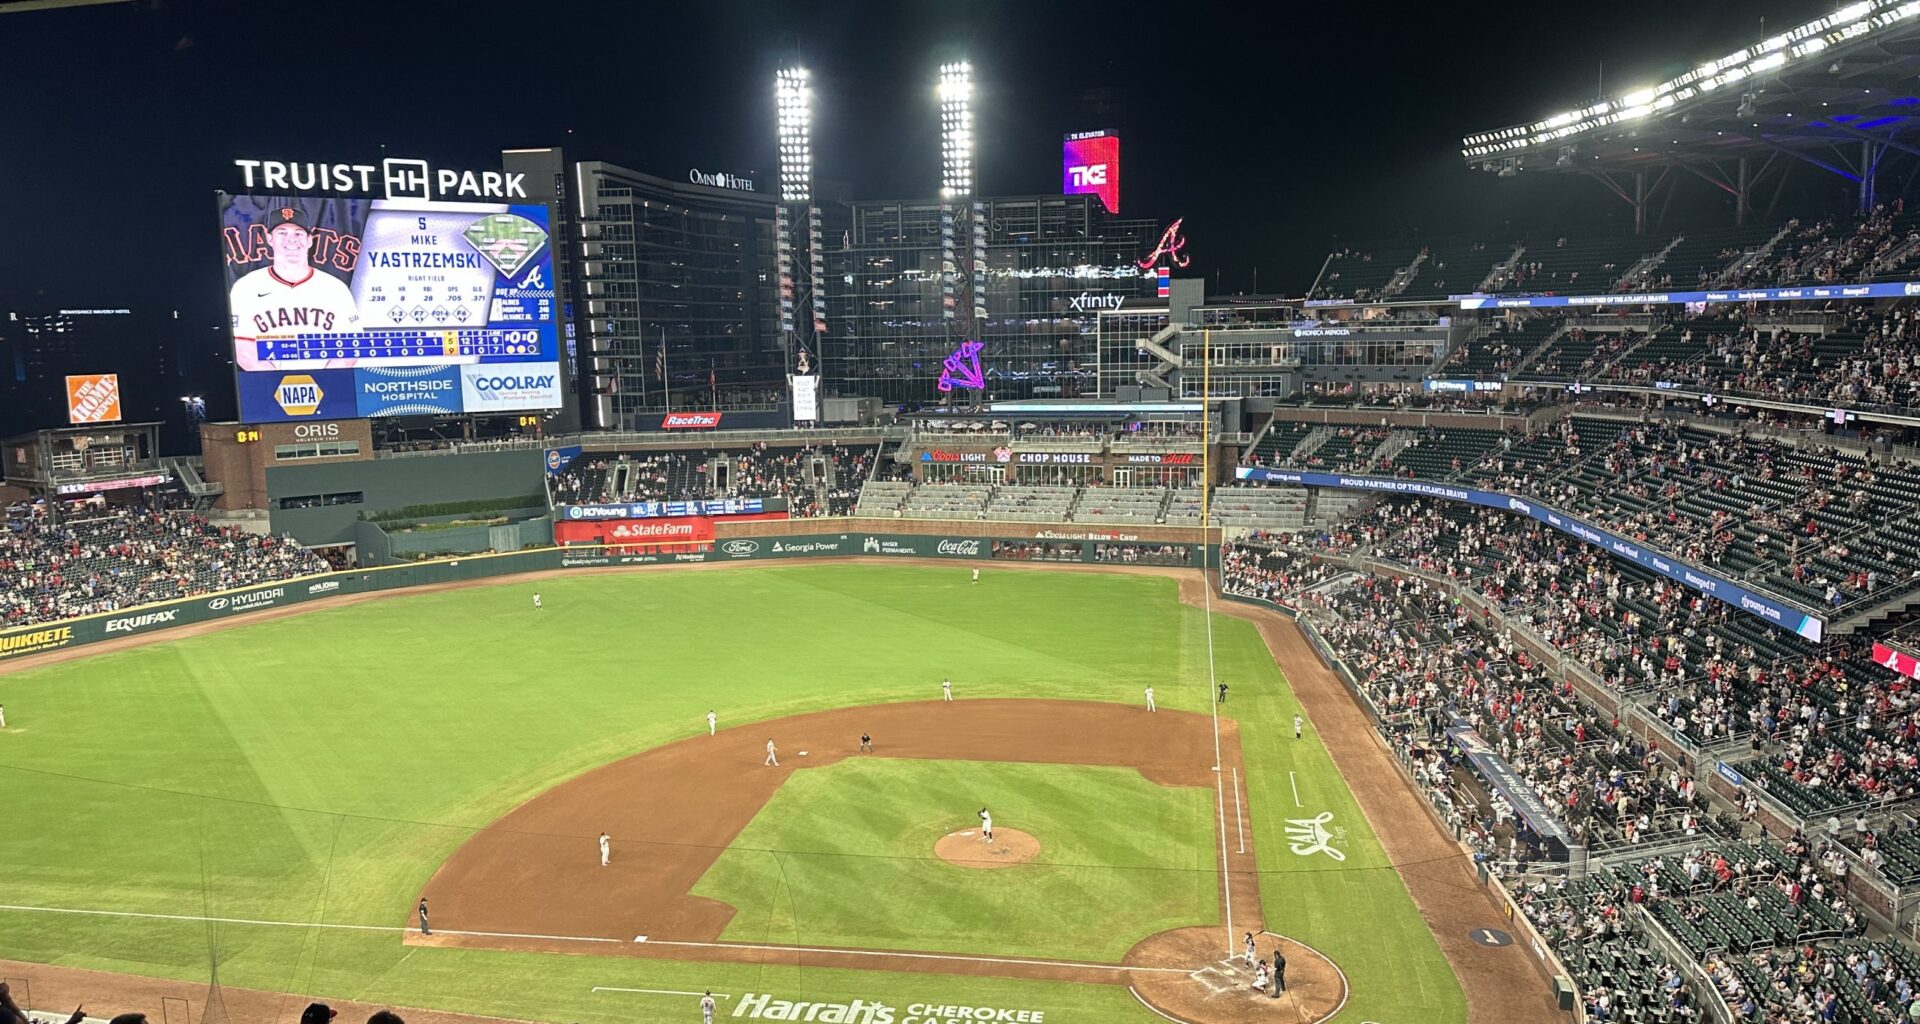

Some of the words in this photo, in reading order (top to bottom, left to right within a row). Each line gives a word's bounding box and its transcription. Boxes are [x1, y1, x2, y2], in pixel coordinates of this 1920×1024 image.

[1079, 130, 1105, 139] ELEVATOR
[235, 159, 375, 192] TRUIST
[438, 169, 527, 199] PARK
[690, 168, 716, 186] OMNI
[725, 173, 755, 191] HOTEL
[1069, 164, 1107, 187] TKE
[411, 235, 438, 245] MIKE
[368, 251, 481, 269] YASTRZEMSKI
[1069, 291, 1125, 313] xfinity
[253, 307, 335, 333] GIANTS
[303, 340, 308, 348] 1
[320, 339, 325, 348] 1
[336, 339, 343, 348] 0
[352, 339, 359, 347] 0
[370, 338, 375, 347] 1
[384, 338, 392, 346] 0
[401, 338, 406, 346] 1
[416, 338, 423, 346] 0
[461, 337, 470, 345] 12
[477, 337, 484, 345] 2
[509, 331, 521, 344] 0
[526, 331, 538, 344] 0
[304, 350, 311, 359] 5
[320, 350, 328, 358] 0
[337, 349, 344, 358] 0
[353, 349, 361, 357] 3
[369, 349, 377, 357] 0
[387, 348, 392, 356] 1
[401, 348, 409, 356] 0
[449, 347, 455, 355] 9
[463, 346, 470, 354] 8
[478, 346, 485, 354] 0
[493, 346, 500, 354] 7
[74, 380, 95, 399] THE
[365, 379, 453, 393] NORTHSIDE
[476, 375, 555, 391] COOLRAY
[72, 375, 115, 421] HOME
[283, 387, 316, 405] NAPA
[382, 392, 438, 401] HOSPITAL
[90, 391, 118, 421] DEPOT
[667, 416, 715, 425] RaceTrac
[295, 423, 339, 437] ORIS
[932, 449, 960, 462] Coors
[960, 453, 986, 462] LIGHT
[1020, 454, 1049, 463] CHOP
[1053, 454, 1090, 463] HOUSE
[1128, 455, 1150, 463] MADE
[1340, 478, 1364, 487] PROUD
[1365, 480, 1396, 490] PARTNER
[1408, 484, 1421, 492] THE
[1421, 485, 1445, 495] ATLANTA
[583, 507, 627, 517] RJYoung
[633, 506, 646, 515] NL
[728, 542, 752, 553] Ford
[785, 543, 814, 552] Georgia
[815, 542, 838, 550] Power
[1685, 571, 1710, 589] Managed
[231, 588, 284, 606] HYUNDAI
[1742, 595, 1781, 620] rjyoung.com
[105, 609, 177, 632] EQUIFAX
[907, 1003, 1045, 1024] CHEROKEE
